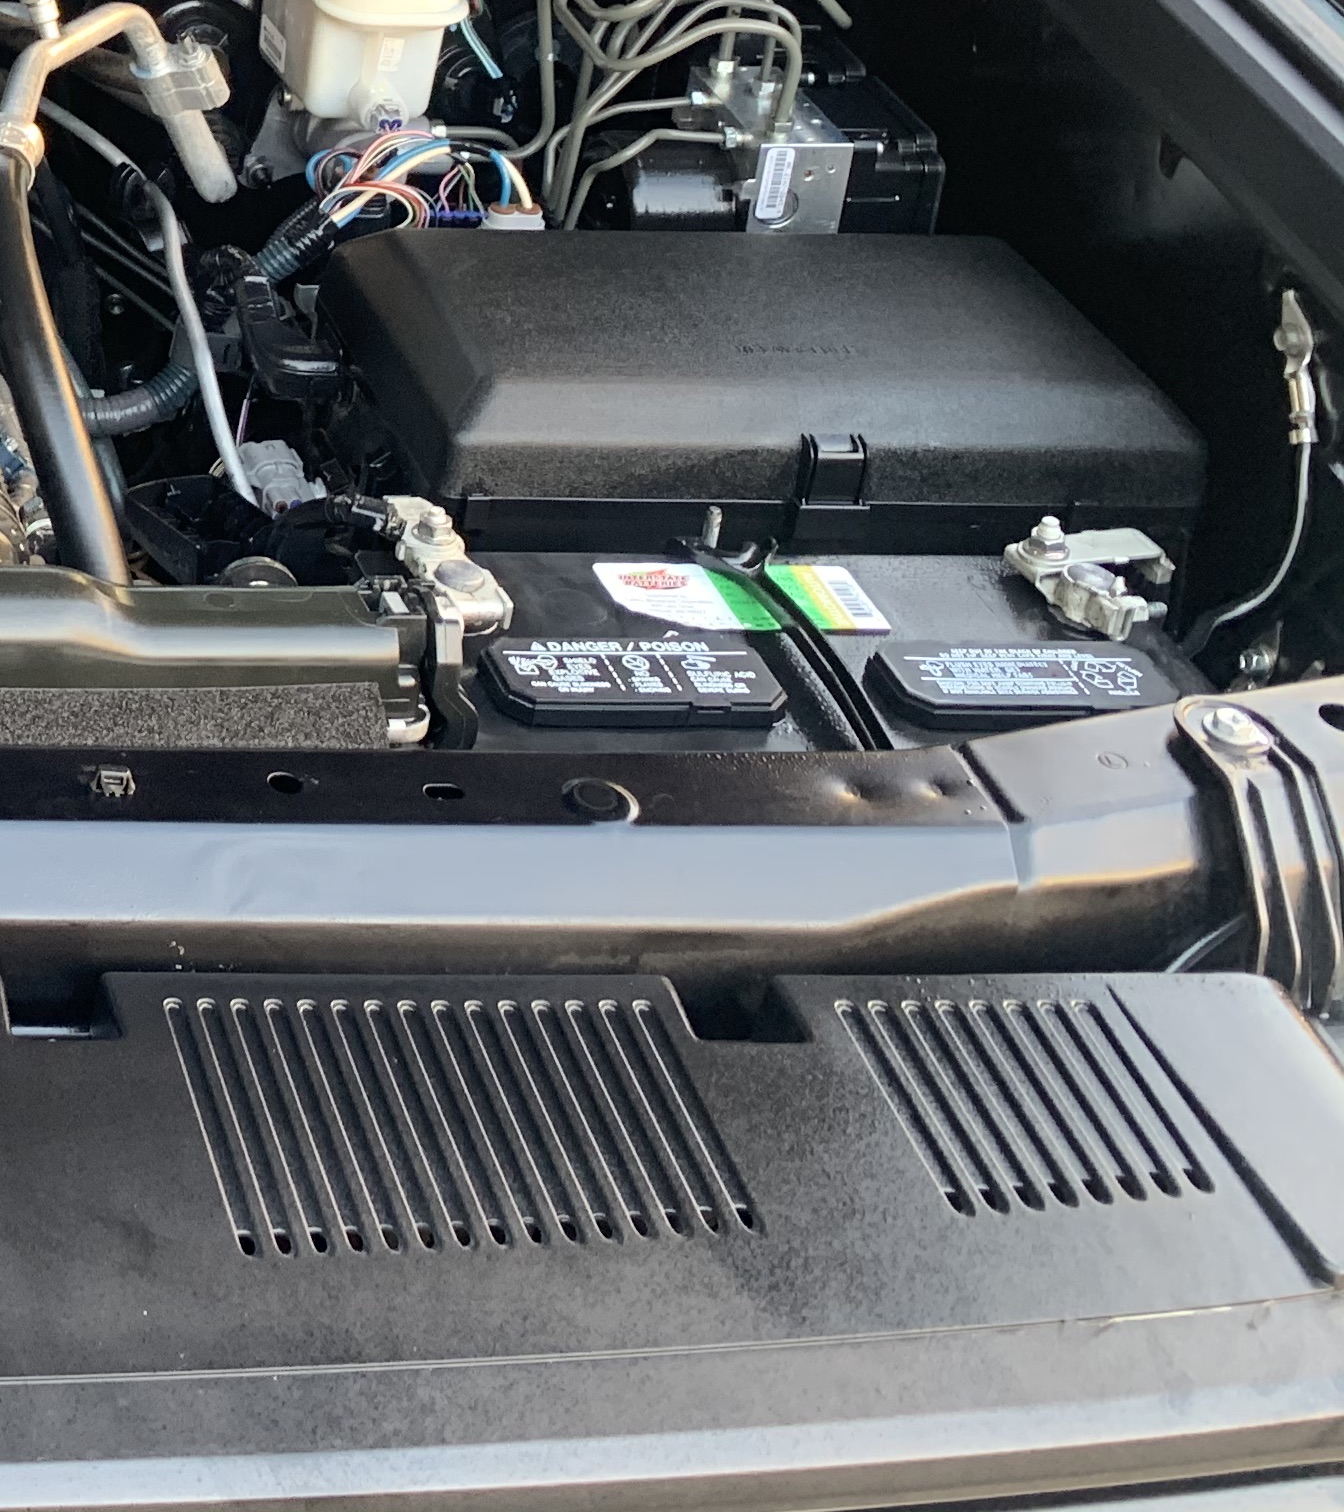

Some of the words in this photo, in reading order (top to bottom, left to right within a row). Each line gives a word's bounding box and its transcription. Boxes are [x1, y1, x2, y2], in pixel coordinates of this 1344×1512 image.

[618, 574, 690, 582] INTERSTATE
[623, 580, 689, 588] BATTERIES
[547, 641, 622, 652] DANGER
[639, 641, 710, 652] POISON
